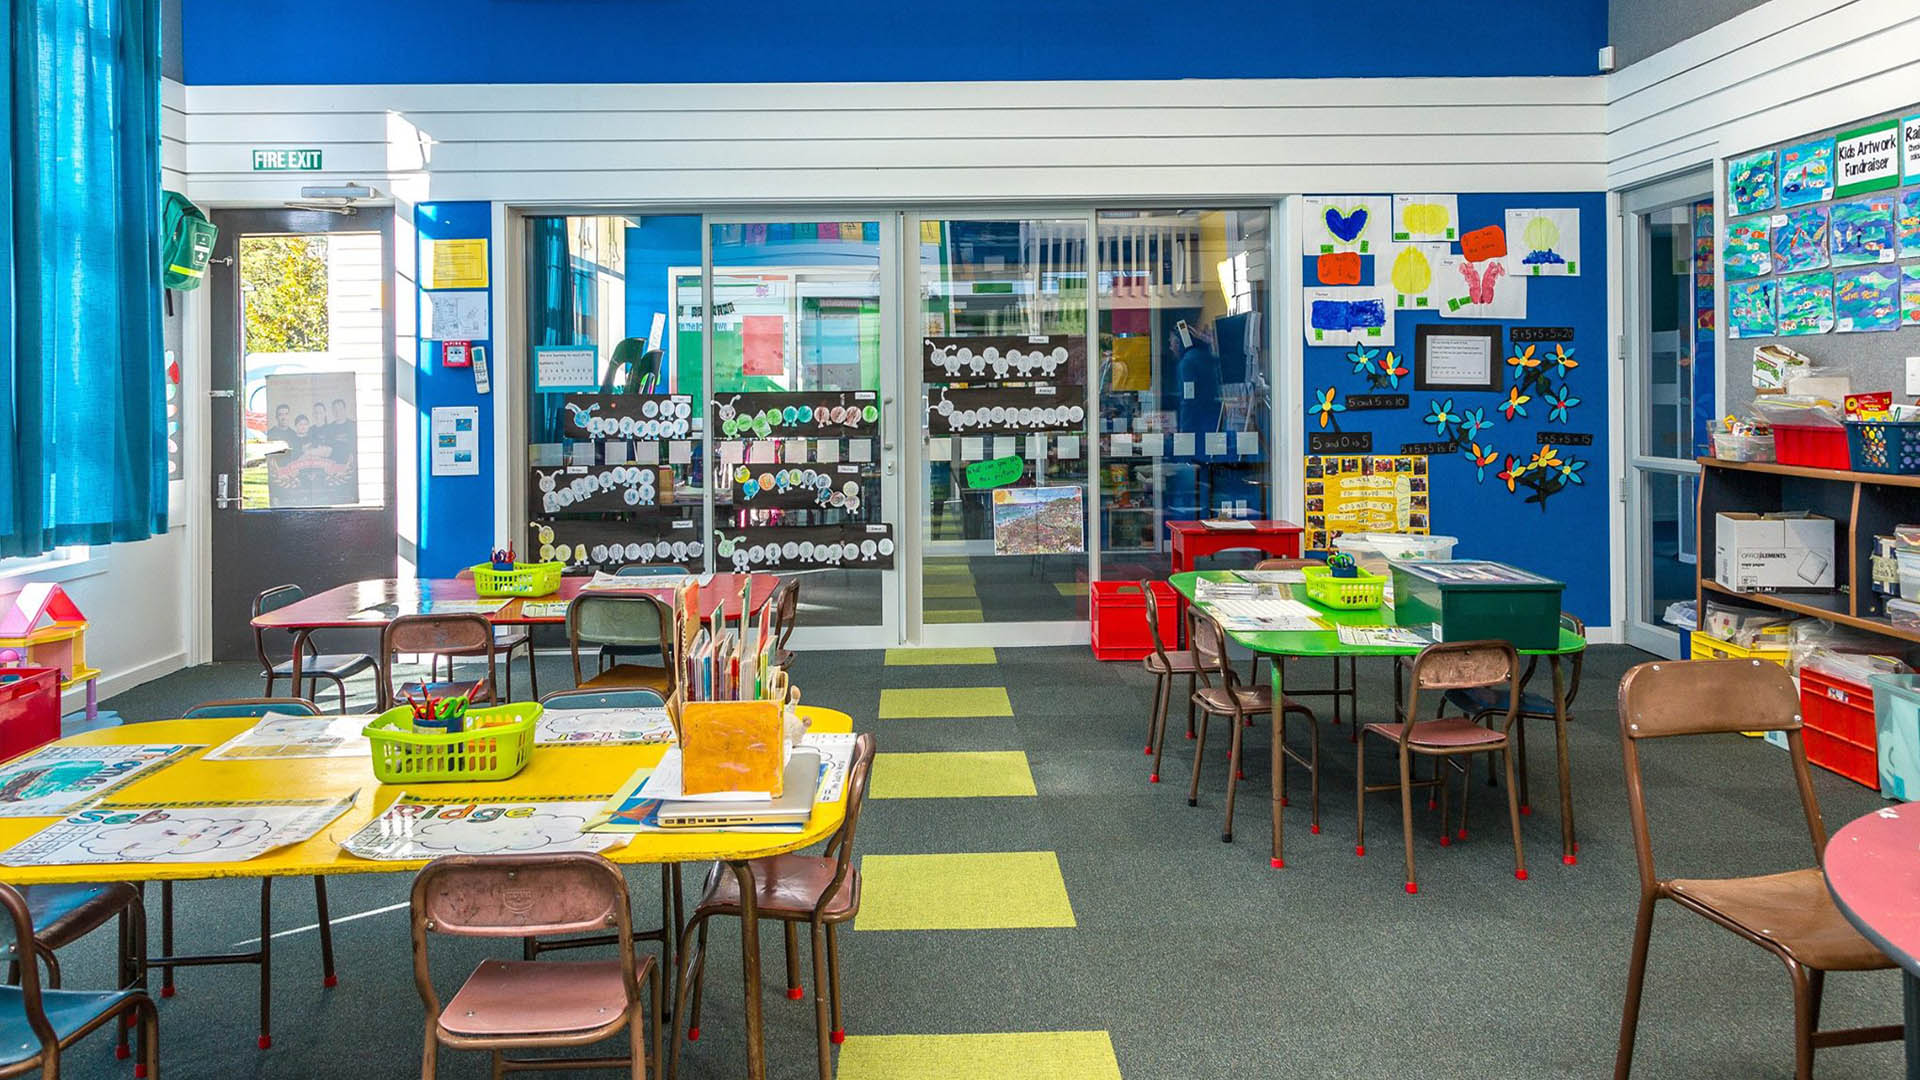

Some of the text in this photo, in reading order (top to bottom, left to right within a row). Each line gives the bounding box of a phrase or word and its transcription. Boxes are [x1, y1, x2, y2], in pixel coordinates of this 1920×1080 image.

[1839, 144, 1856, 161] Kids
[1857, 134, 1896, 156] Artwork
[255, 151, 320, 168] FIRE EXIT
[1845, 157, 1889, 177] Fundraiser
[1312, 436, 1322, 450] 5
[1325, 440, 1339, 448] and
[1341, 436, 1350, 447] 0
[1361, 435, 1369, 448] 5
[384, 803, 537, 823] Ridge
